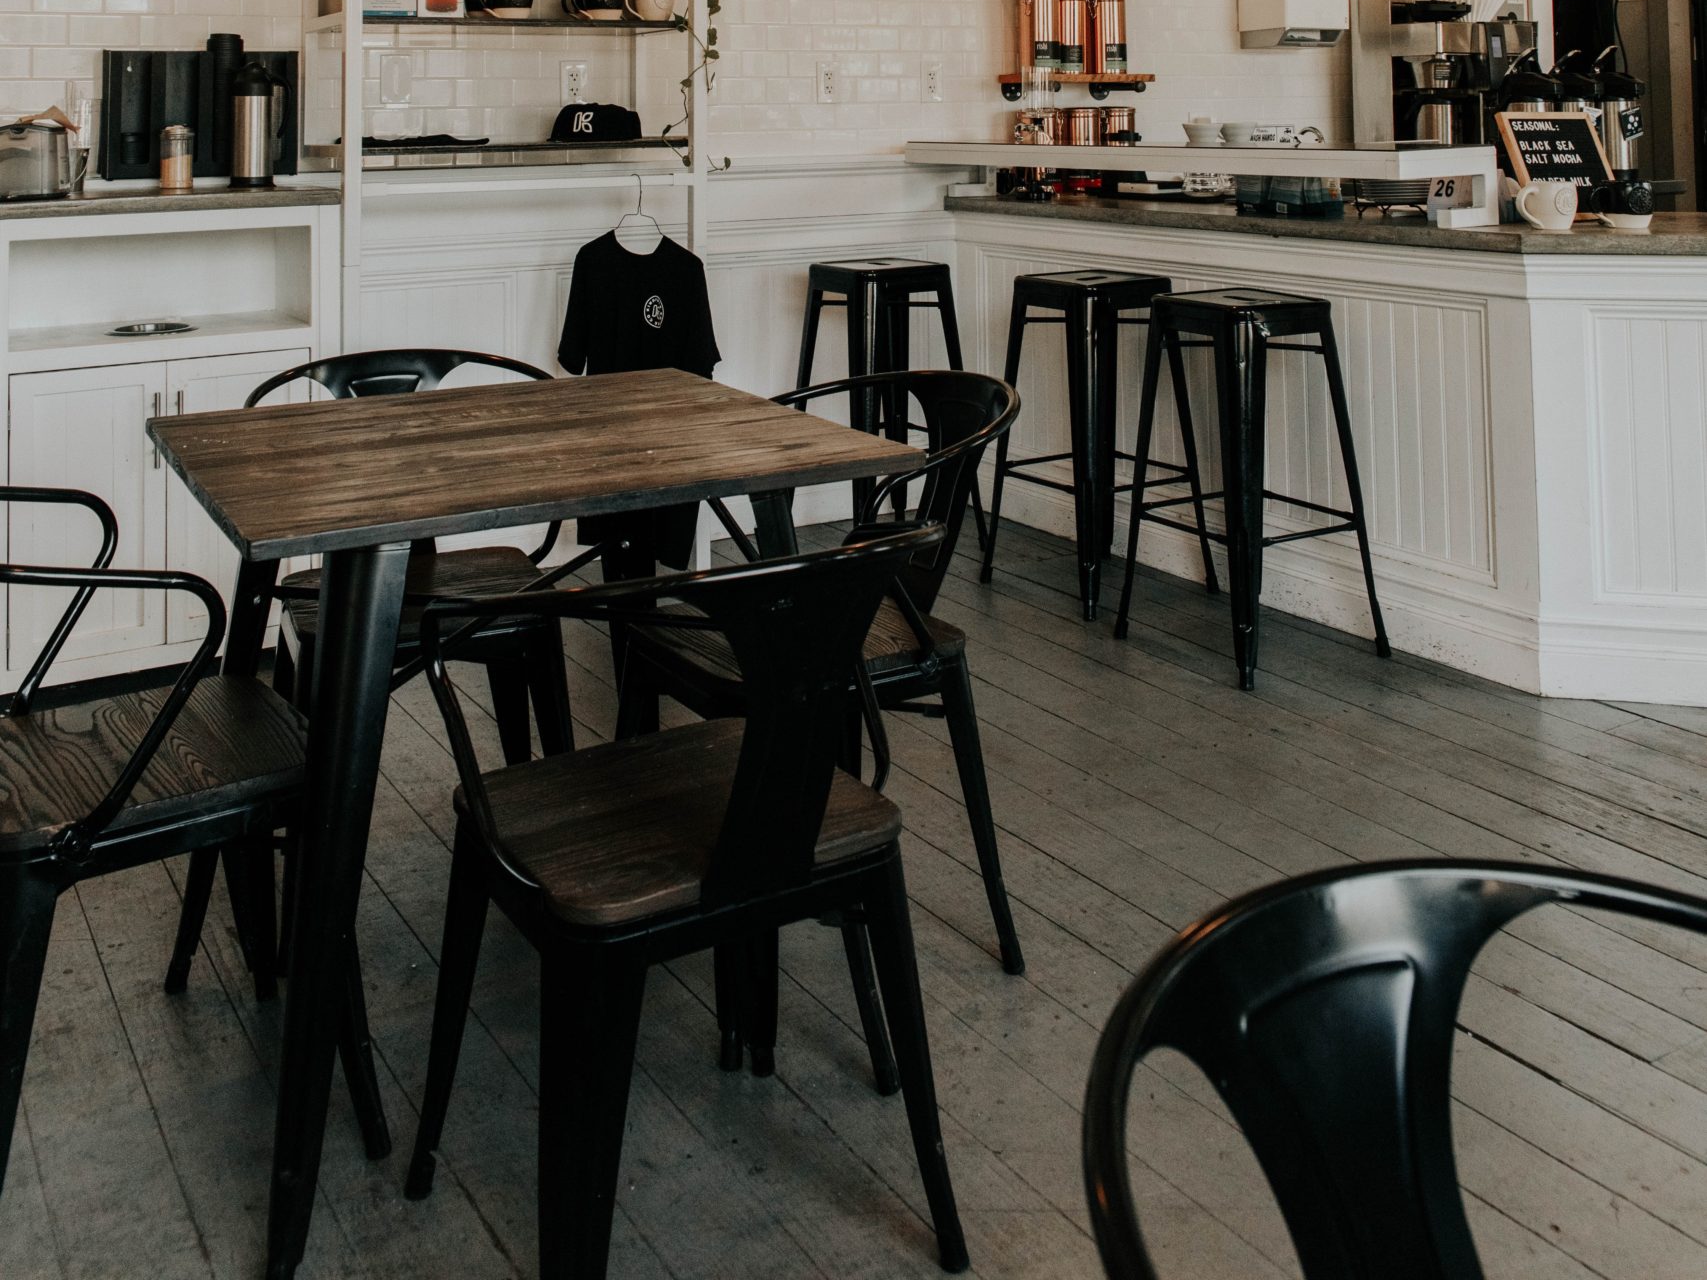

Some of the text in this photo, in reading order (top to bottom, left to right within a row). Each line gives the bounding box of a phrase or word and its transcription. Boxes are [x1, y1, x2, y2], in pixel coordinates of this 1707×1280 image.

[1512, 121, 1560, 131] SEASONAL:
[1519, 141, 1575, 151] BLACK SEA
[1525, 154, 1583, 164] SALT MOCHA
[1570, 177, 1592, 186] MILK
[1434, 179, 1455, 197] 26
